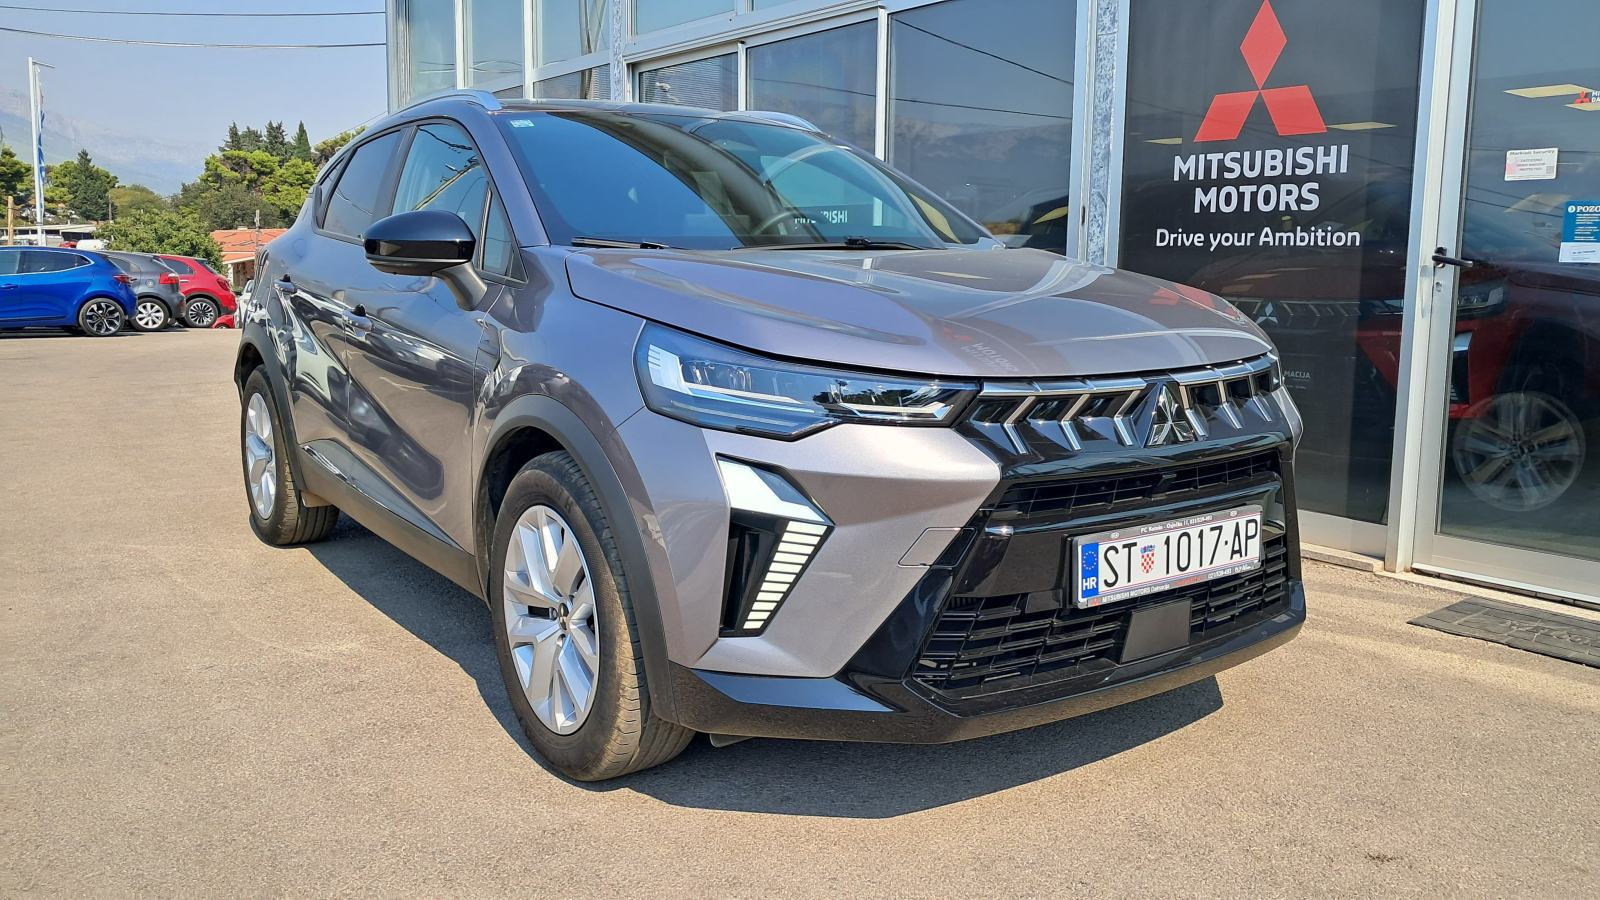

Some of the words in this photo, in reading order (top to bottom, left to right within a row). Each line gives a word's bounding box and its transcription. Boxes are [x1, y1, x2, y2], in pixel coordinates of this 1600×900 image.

[1173, 145, 1349, 181] MITSUBISHI
[1194, 182, 1320, 213] MOTORS
[1156, 227, 1204, 247] Drive
[1209, 231, 1255, 252] your
[1258, 225, 1361, 247] Ambition
[1284, 370, 1311, 380] MACIJA
[1103, 542, 1138, 588] ST
[1082, 577, 1097, 590] HR
